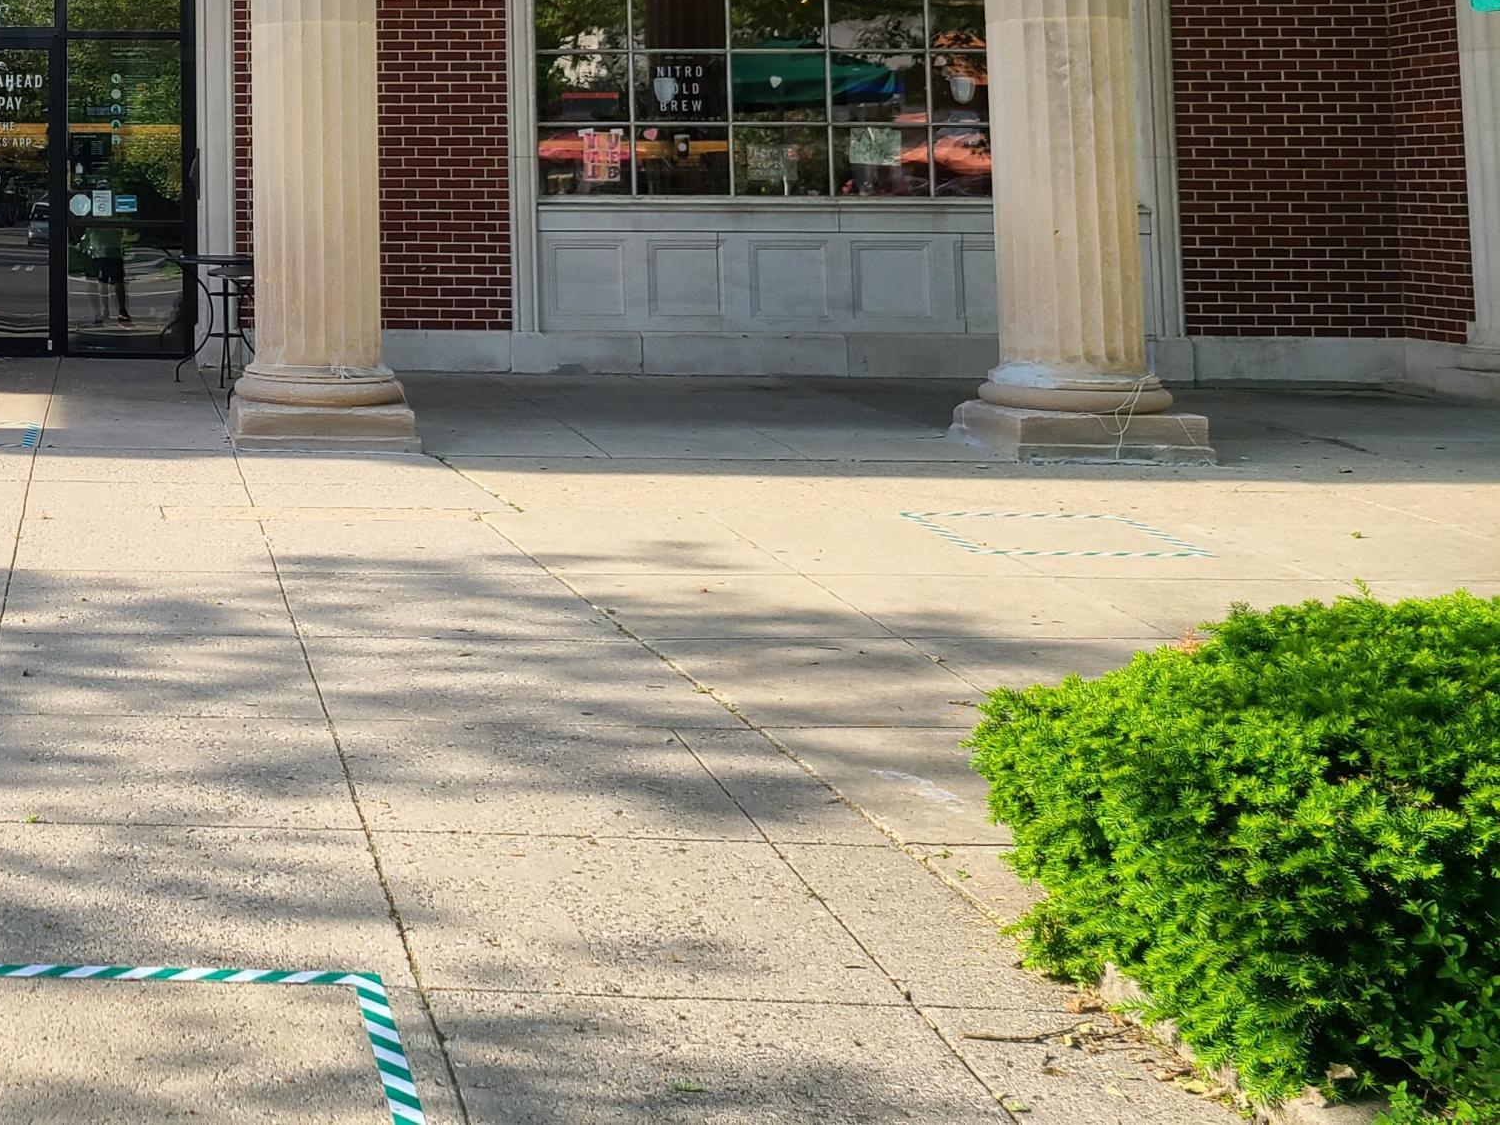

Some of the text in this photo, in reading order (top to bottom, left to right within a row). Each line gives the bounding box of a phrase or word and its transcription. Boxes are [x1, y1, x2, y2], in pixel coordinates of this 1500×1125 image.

[656, 65, 703, 78] NITRO
[670, 82, 700, 95] OLD
[660, 100, 702, 112] BREW
[12, 137, 32, 148] APP
